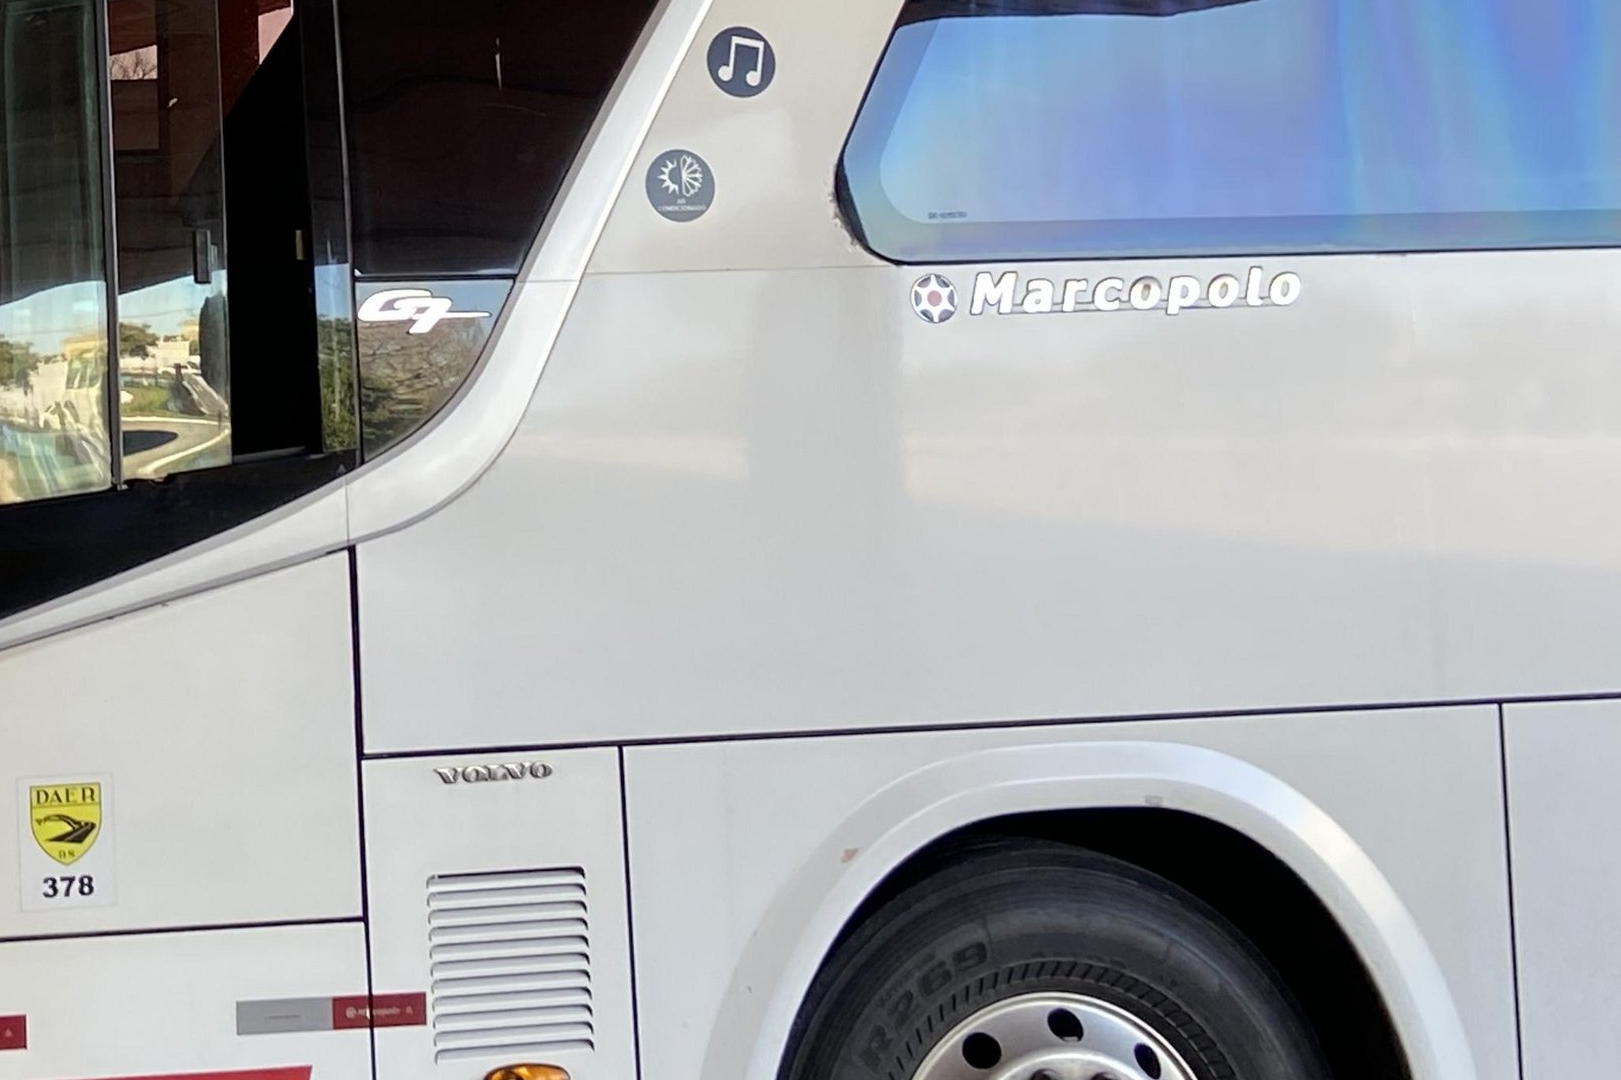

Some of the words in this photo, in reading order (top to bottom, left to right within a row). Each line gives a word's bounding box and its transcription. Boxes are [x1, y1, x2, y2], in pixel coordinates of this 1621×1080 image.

[969, 264, 1304, 317] Marcopolo
[433, 761, 554, 785] VOLVO
[35, 786, 96, 805] DAER
[42, 875, 95, 899] 378
